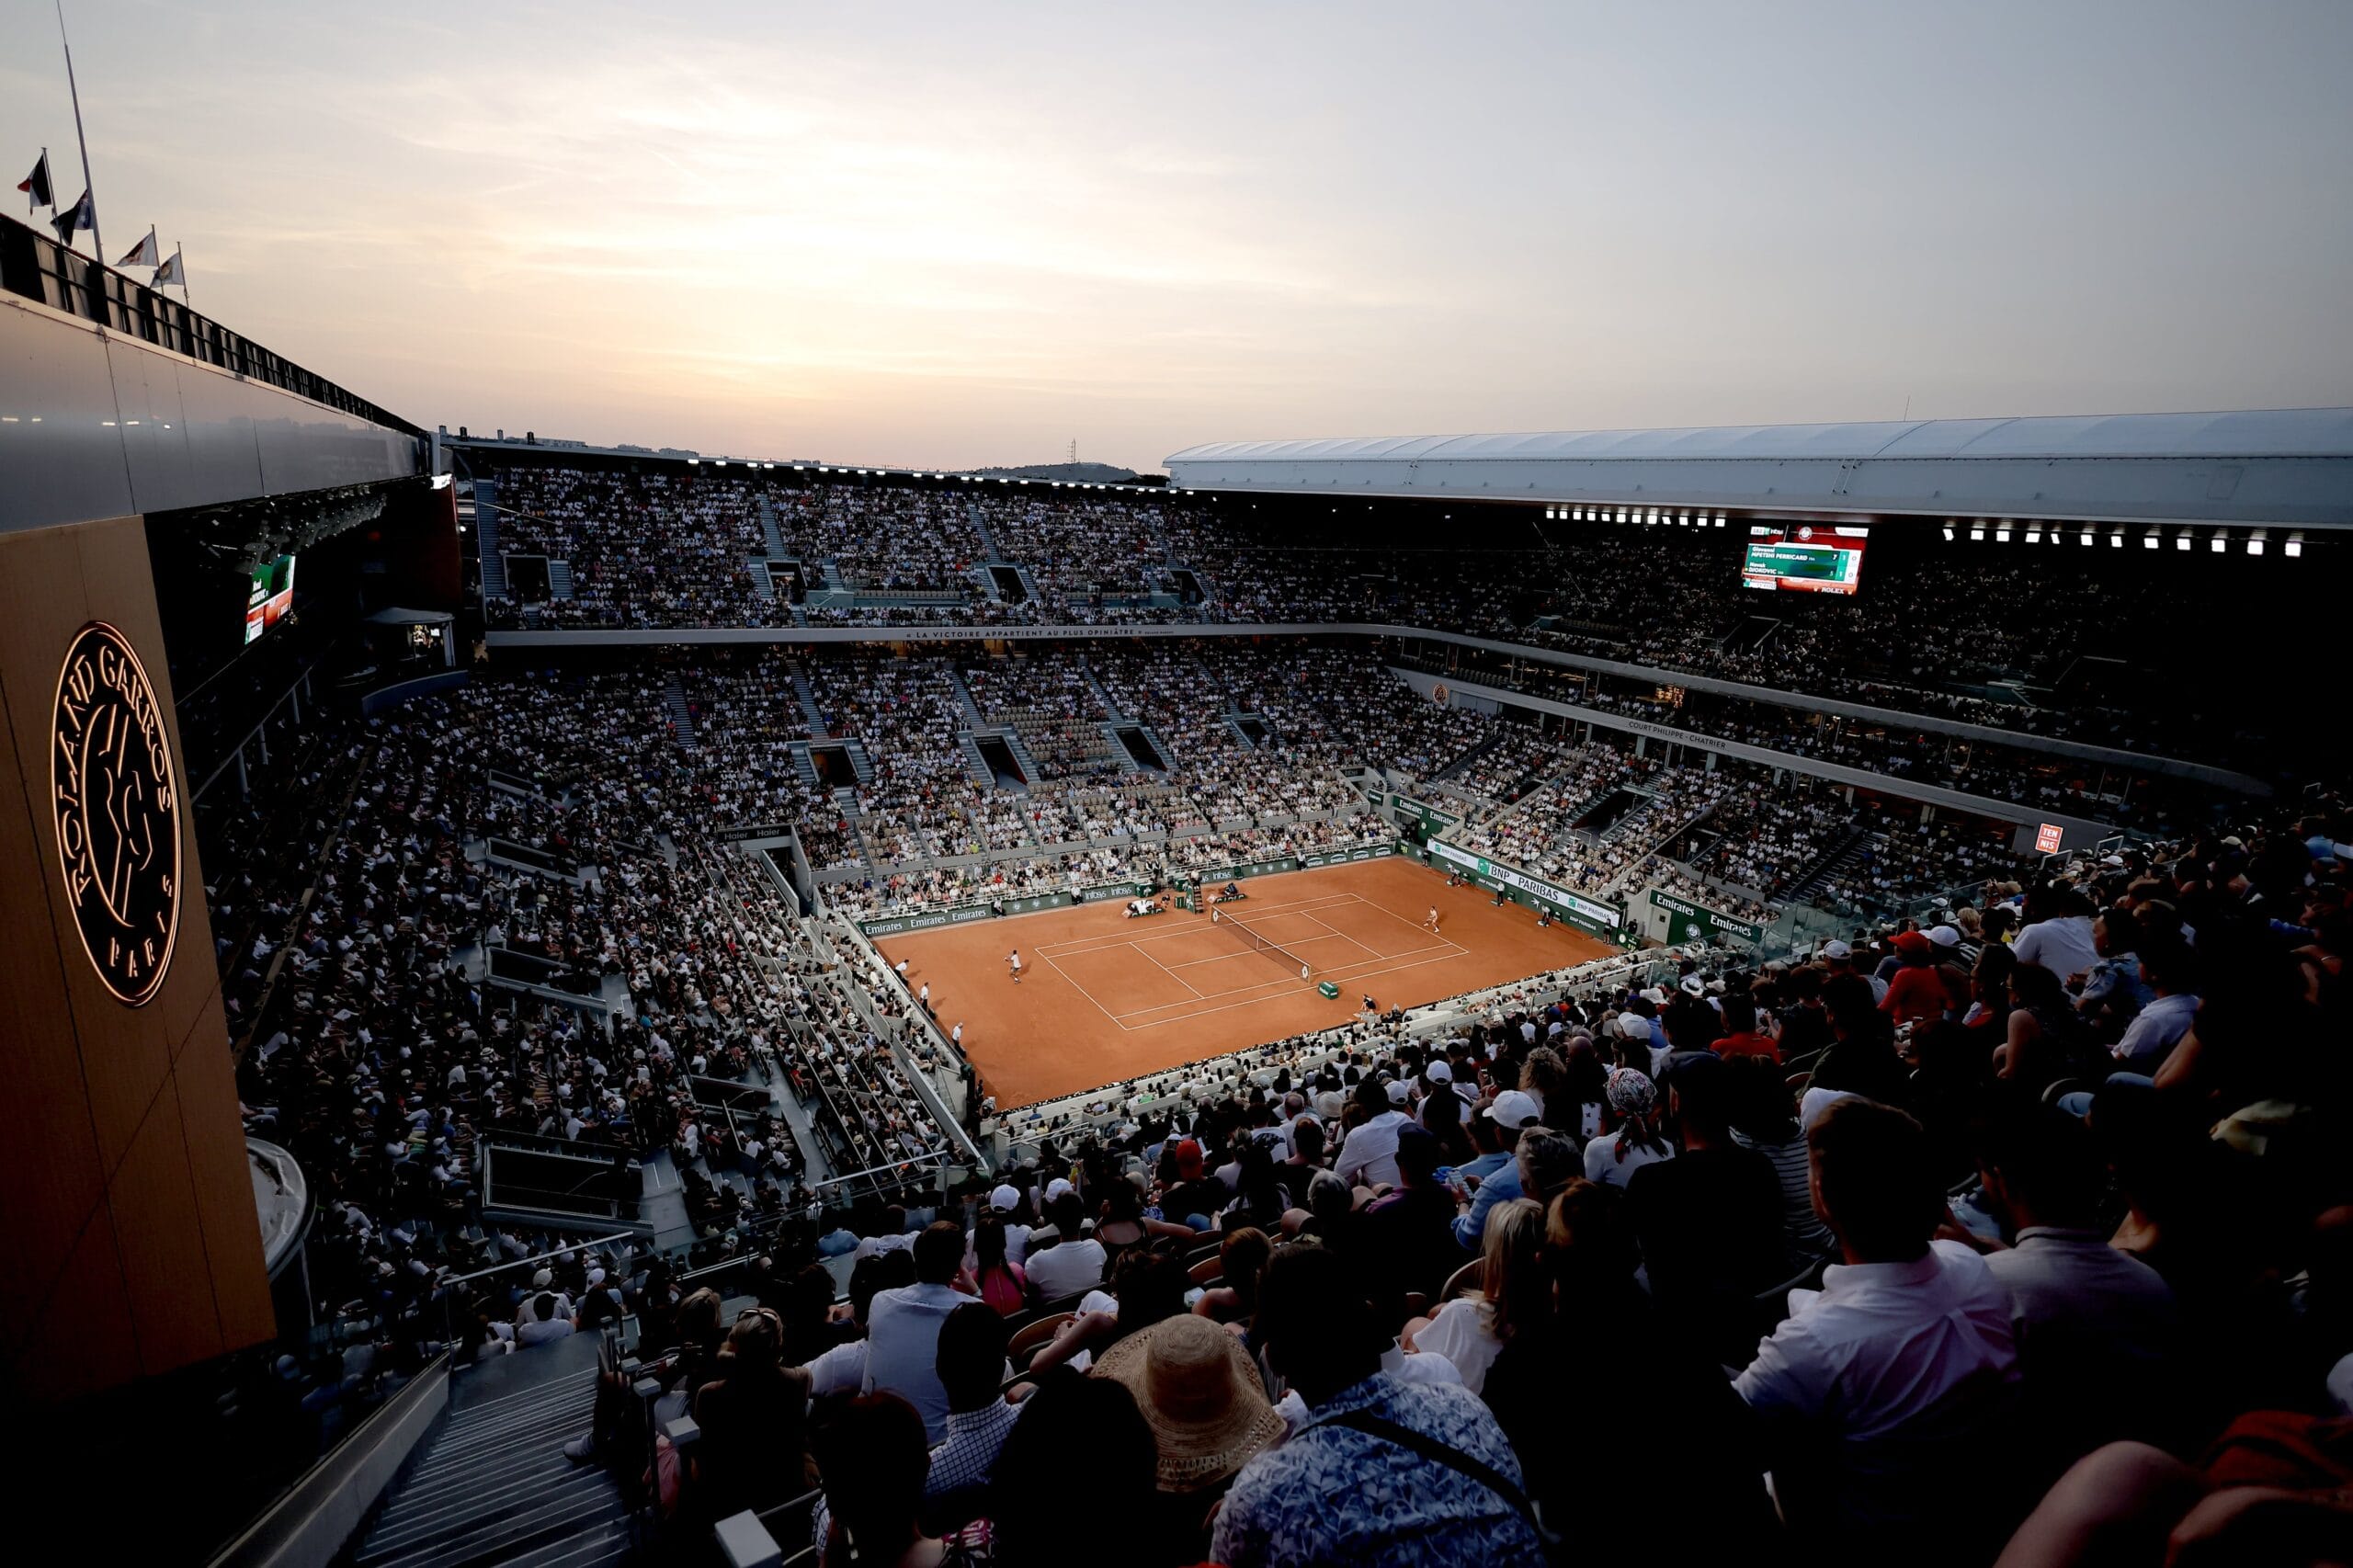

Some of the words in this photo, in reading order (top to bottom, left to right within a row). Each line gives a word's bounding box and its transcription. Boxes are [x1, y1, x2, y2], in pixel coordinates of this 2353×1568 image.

[1629, 721, 1652, 733] COURT
[1653, 726, 1684, 740] PHILIPPE
[1689, 734, 1726, 749] CHATRIER
[1399, 799, 1423, 814] Emirates
[1429, 811, 1455, 825] Emirates
[724, 832, 748, 840] Haier
[2042, 828, 2058, 838] TEN
[2040, 839, 2055, 849] NIS
[1451, 851, 1468, 862] PARIBAS
[1491, 866, 1510, 880] BNP
[1518, 877, 1559, 901] PARIBAS
[1576, 902, 1588, 911] BNP
[1656, 894, 1695, 916] Emirates
[1710, 915, 1752, 937] Emirates
[865, 922, 903, 935] Emirates
[910, 915, 946, 928] Emirates
[951, 908, 986, 921] Emirates
[1578, 919, 1597, 930] PARIBAS
